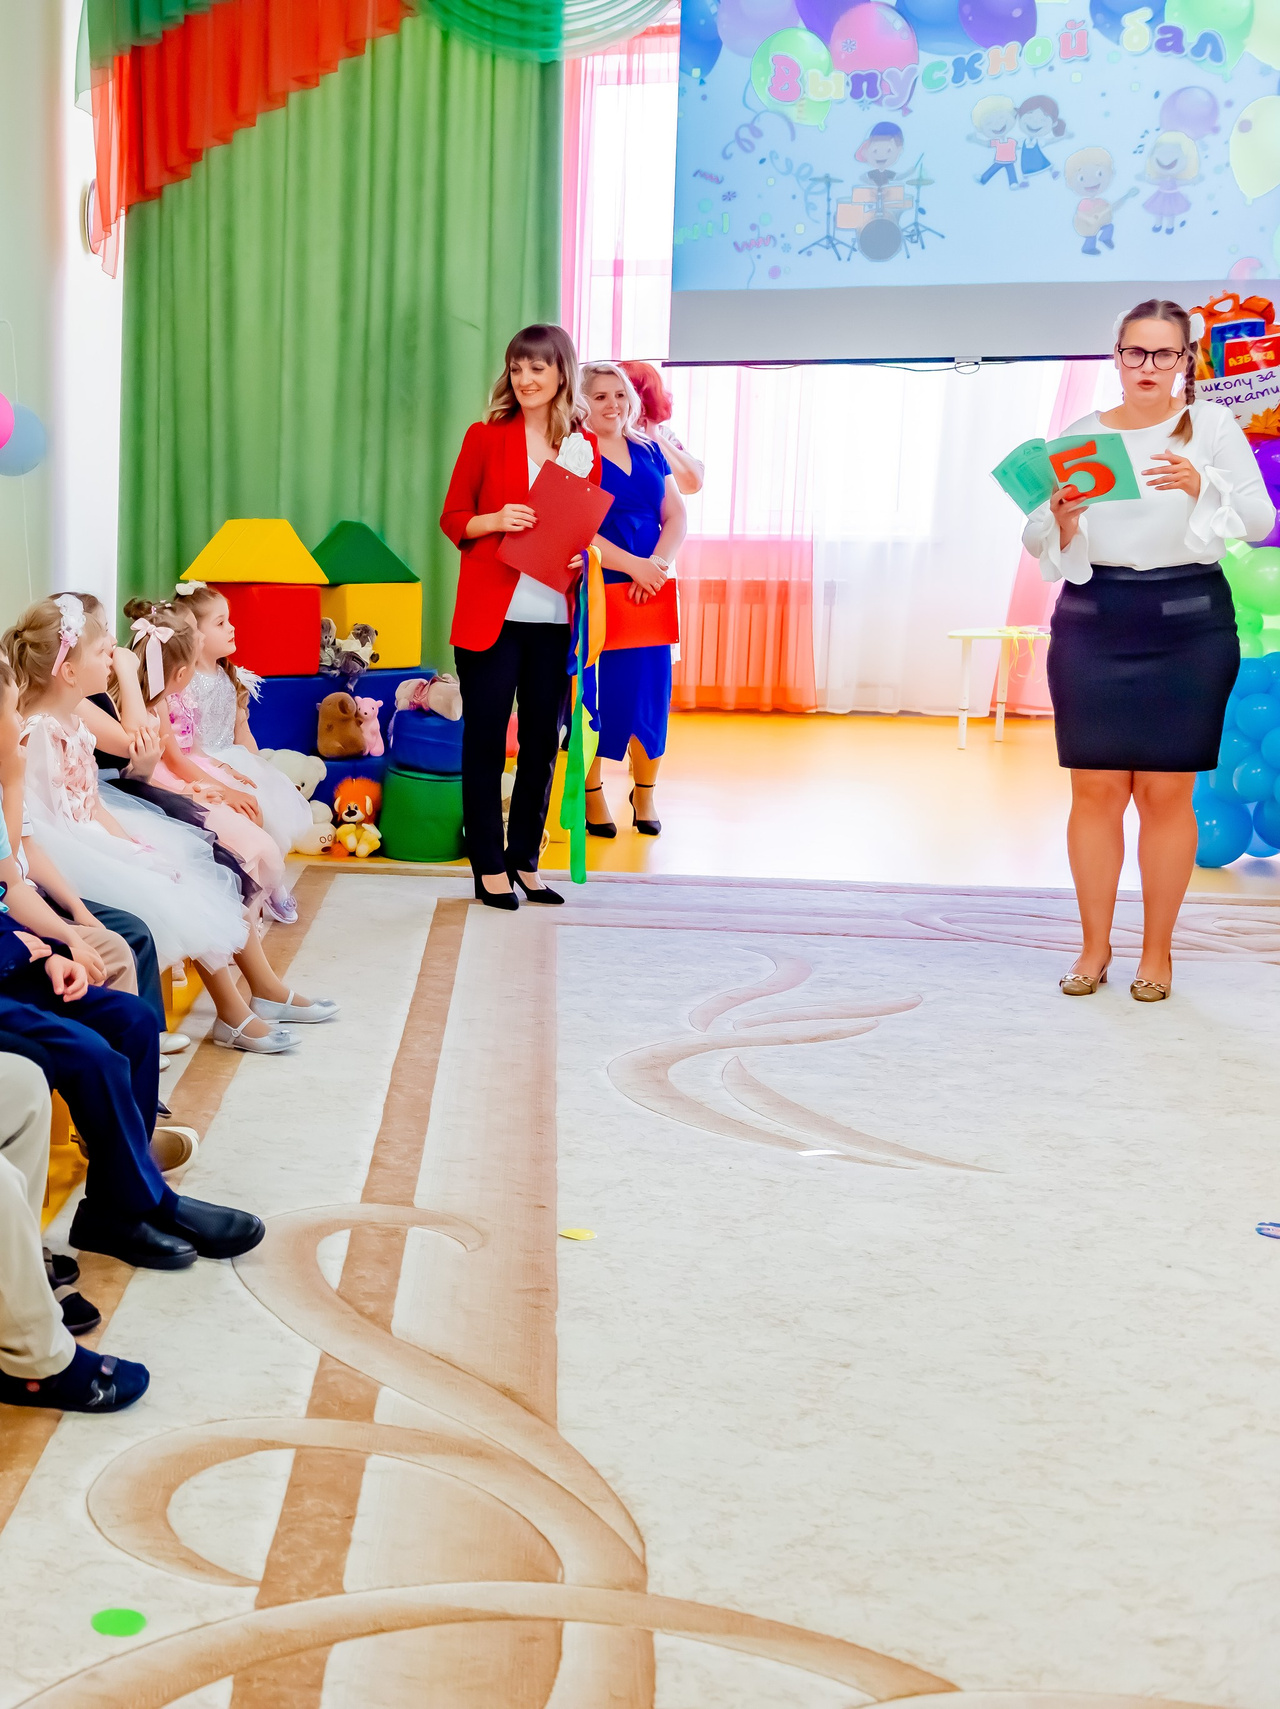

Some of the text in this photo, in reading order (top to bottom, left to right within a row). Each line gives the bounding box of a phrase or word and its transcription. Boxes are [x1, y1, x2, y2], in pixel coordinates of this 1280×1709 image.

[768, 7, 1226, 108] Выпускной бал
[1201, 371, 1276, 393] школу за
[1206, 385, 1280, 407] ёрками
[1049, 440, 1116, 502] 5
